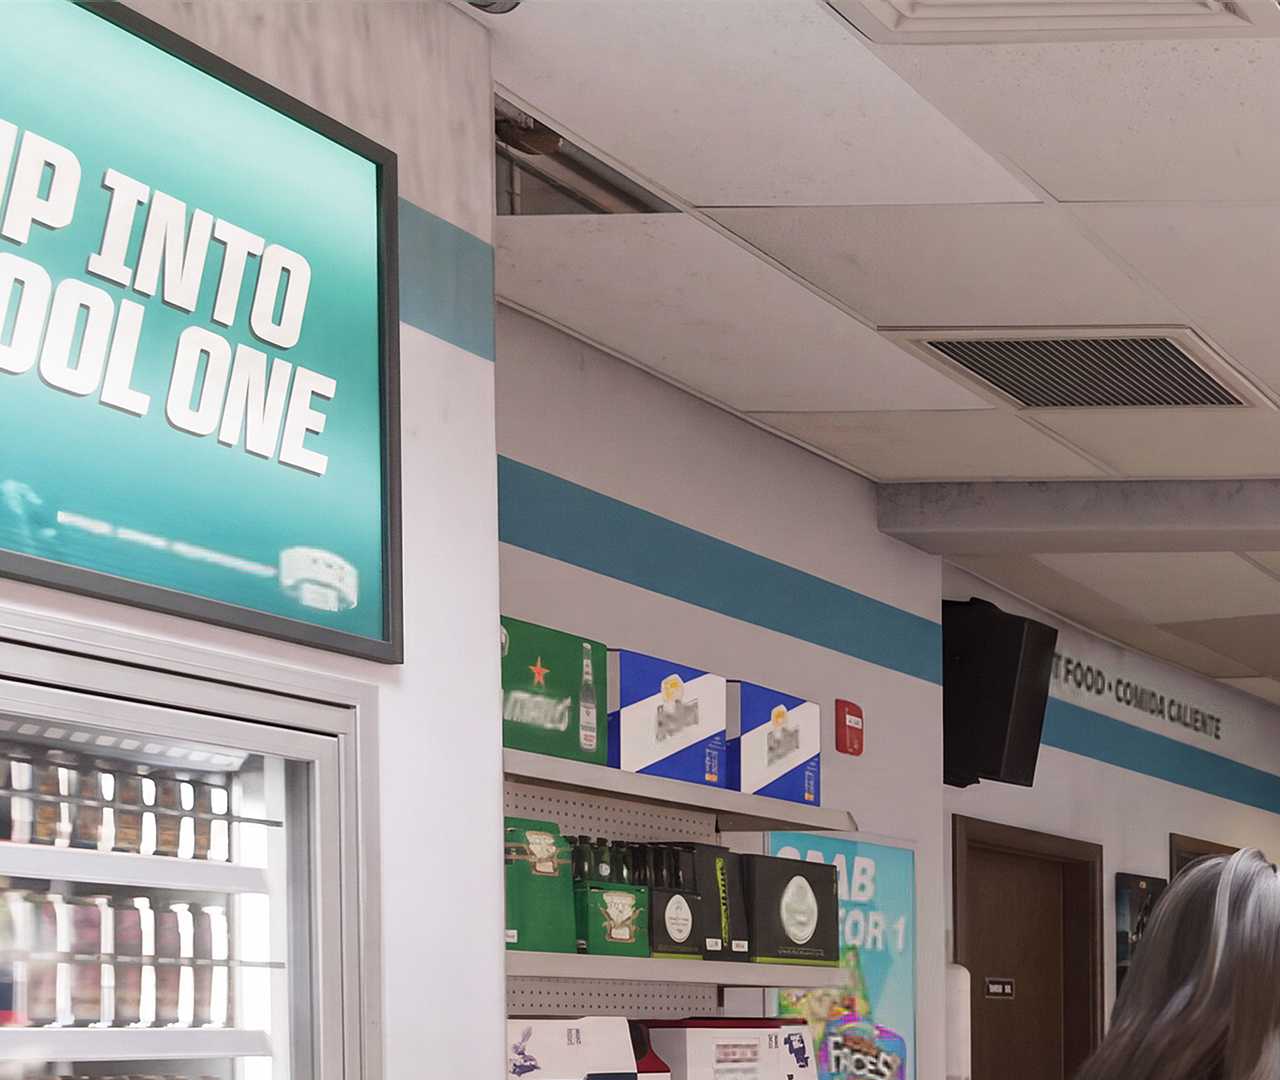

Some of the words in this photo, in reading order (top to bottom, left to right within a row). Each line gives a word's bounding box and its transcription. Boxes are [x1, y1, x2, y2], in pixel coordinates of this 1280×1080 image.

[86, 168, 312, 349] INTO
[164, 325, 337, 476] ONE
[1063, 657, 1106, 695] FOOD
[1114, 678, 1166, 719] COMIDA
[1167, 698, 1222, 740] CALIENTE
[776, 846, 876, 902] AB
[839, 907, 884, 951] OR
